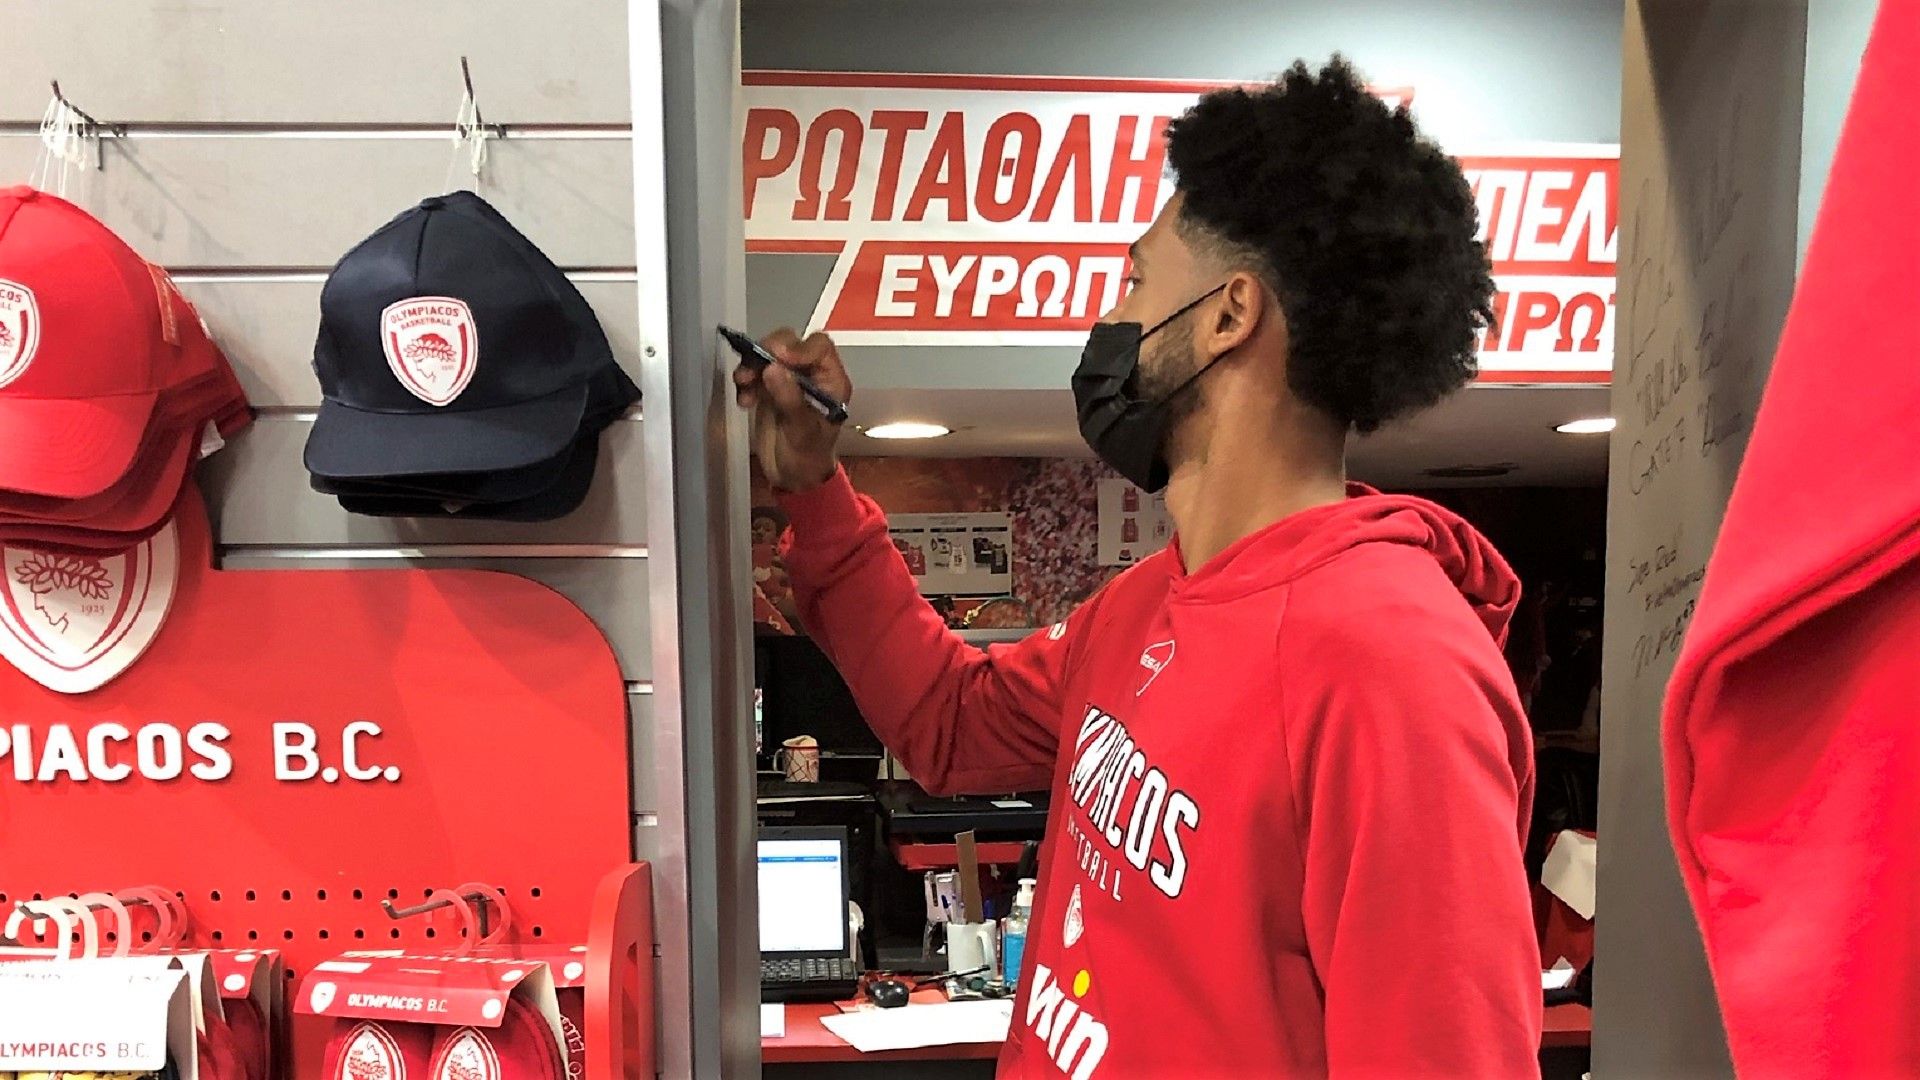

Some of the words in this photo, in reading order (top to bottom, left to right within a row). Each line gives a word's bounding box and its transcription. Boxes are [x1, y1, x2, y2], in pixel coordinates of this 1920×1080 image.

[1463, 169, 1617, 263] ΠΕΛ
[390, 306, 460, 324] OLYMPIACOS
[874, 254, 1132, 318] ΕΥΡΩΠ
[272, 721, 401, 782] B.C.
[347, 992, 424, 1012] OLYMPIACOS
[1026, 963, 1110, 1080] win
[117, 1042, 150, 1058] B.C.
